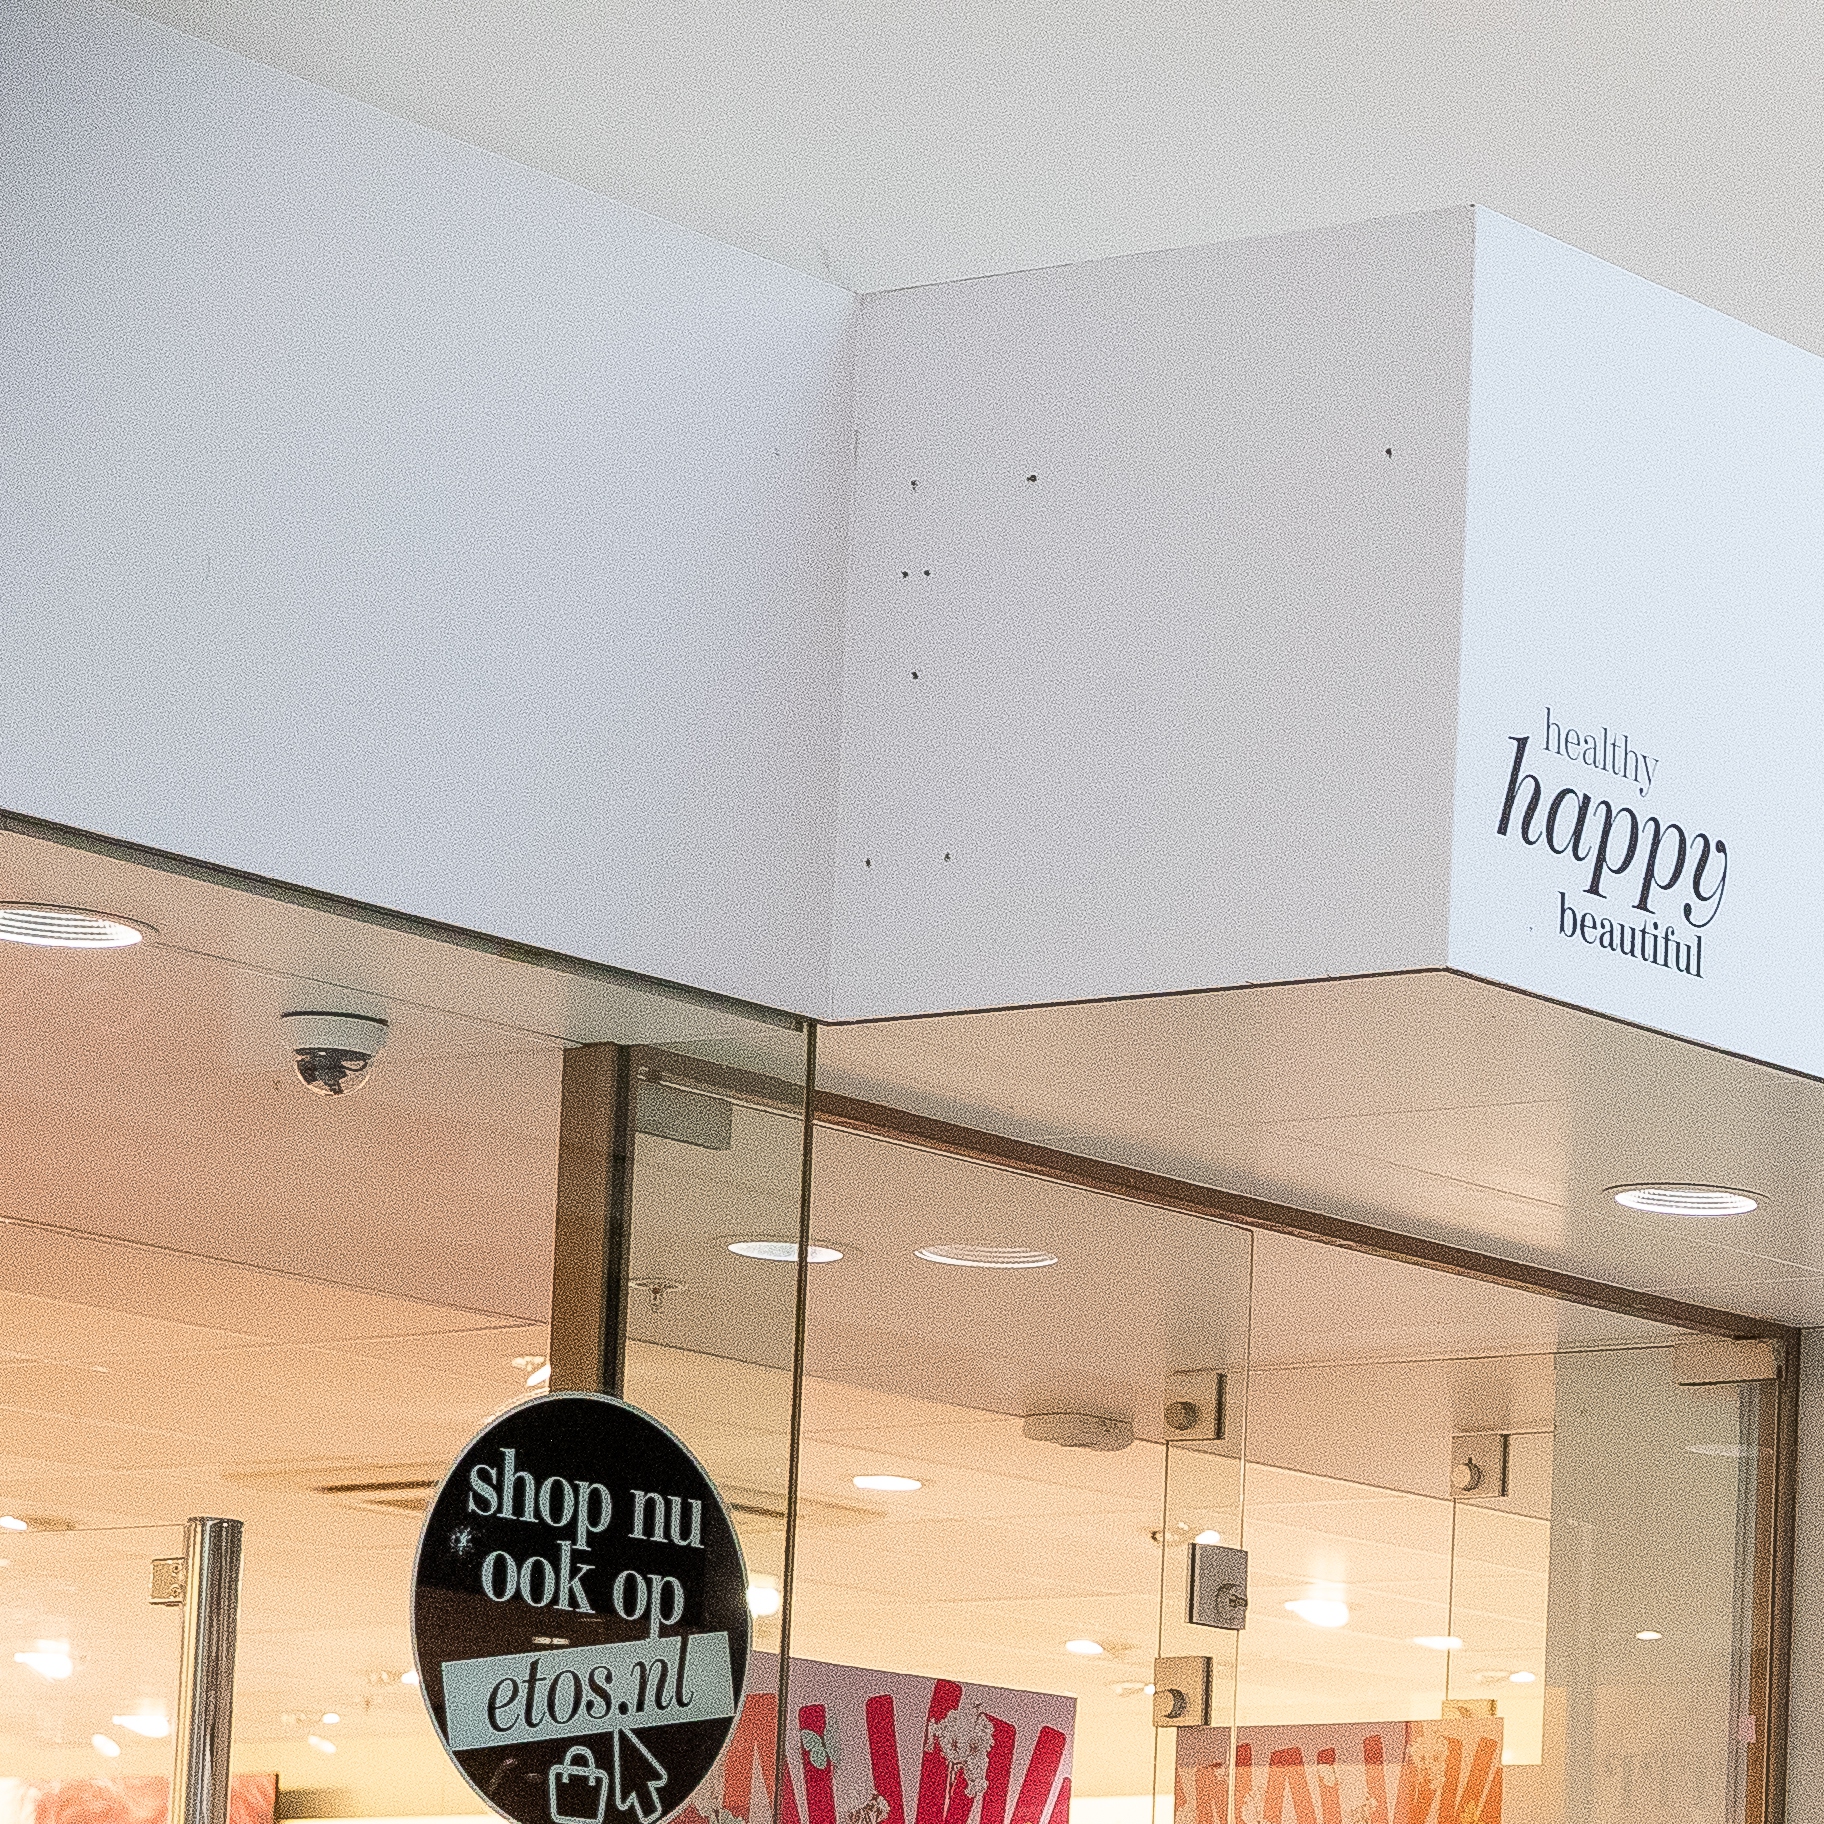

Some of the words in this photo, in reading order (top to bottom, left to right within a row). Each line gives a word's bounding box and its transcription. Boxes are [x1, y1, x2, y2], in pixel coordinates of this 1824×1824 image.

[1543, 706, 1660, 797] healthy
[1496, 735, 1728, 928] happy
[1557, 890, 1704, 979] beautiful
[467, 1448, 612, 1551] shop
[629, 1487, 706, 1550] nu
[481, 1540, 597, 1614] ook
[612, 1567, 686, 1640] op
[486, 1633, 697, 1734] etos.nl
